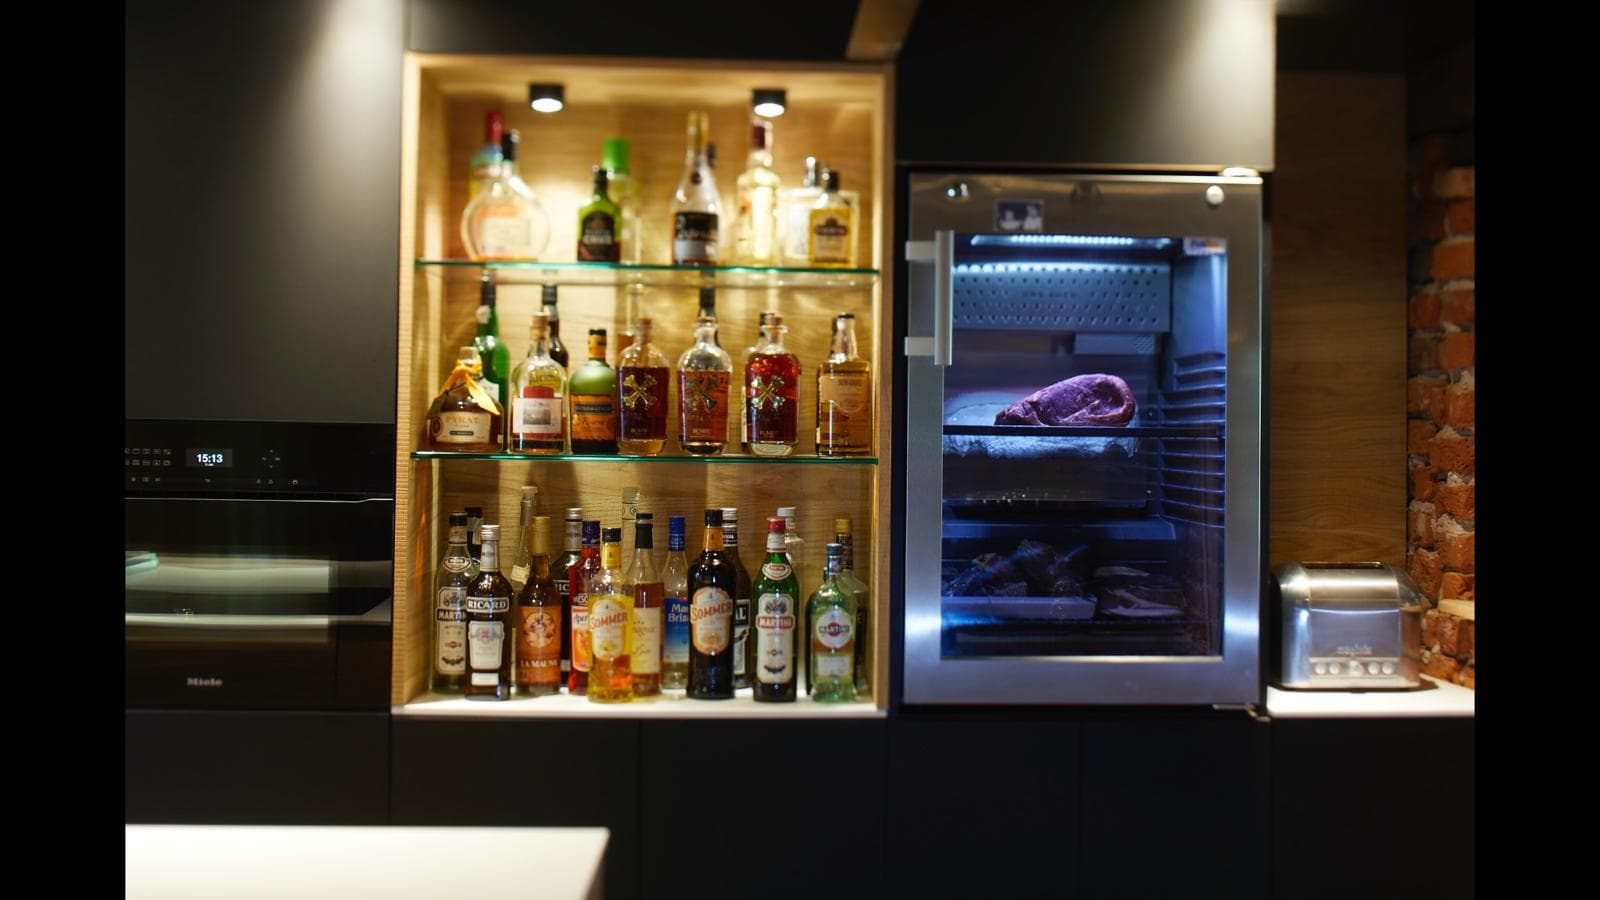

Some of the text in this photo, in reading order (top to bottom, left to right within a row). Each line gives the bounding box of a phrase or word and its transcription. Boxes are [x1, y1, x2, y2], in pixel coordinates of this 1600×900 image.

[196, 453, 224, 463] 15:13
[467, 600, 506, 609] RICARD
[438, 610, 467, 620] MARTIN
